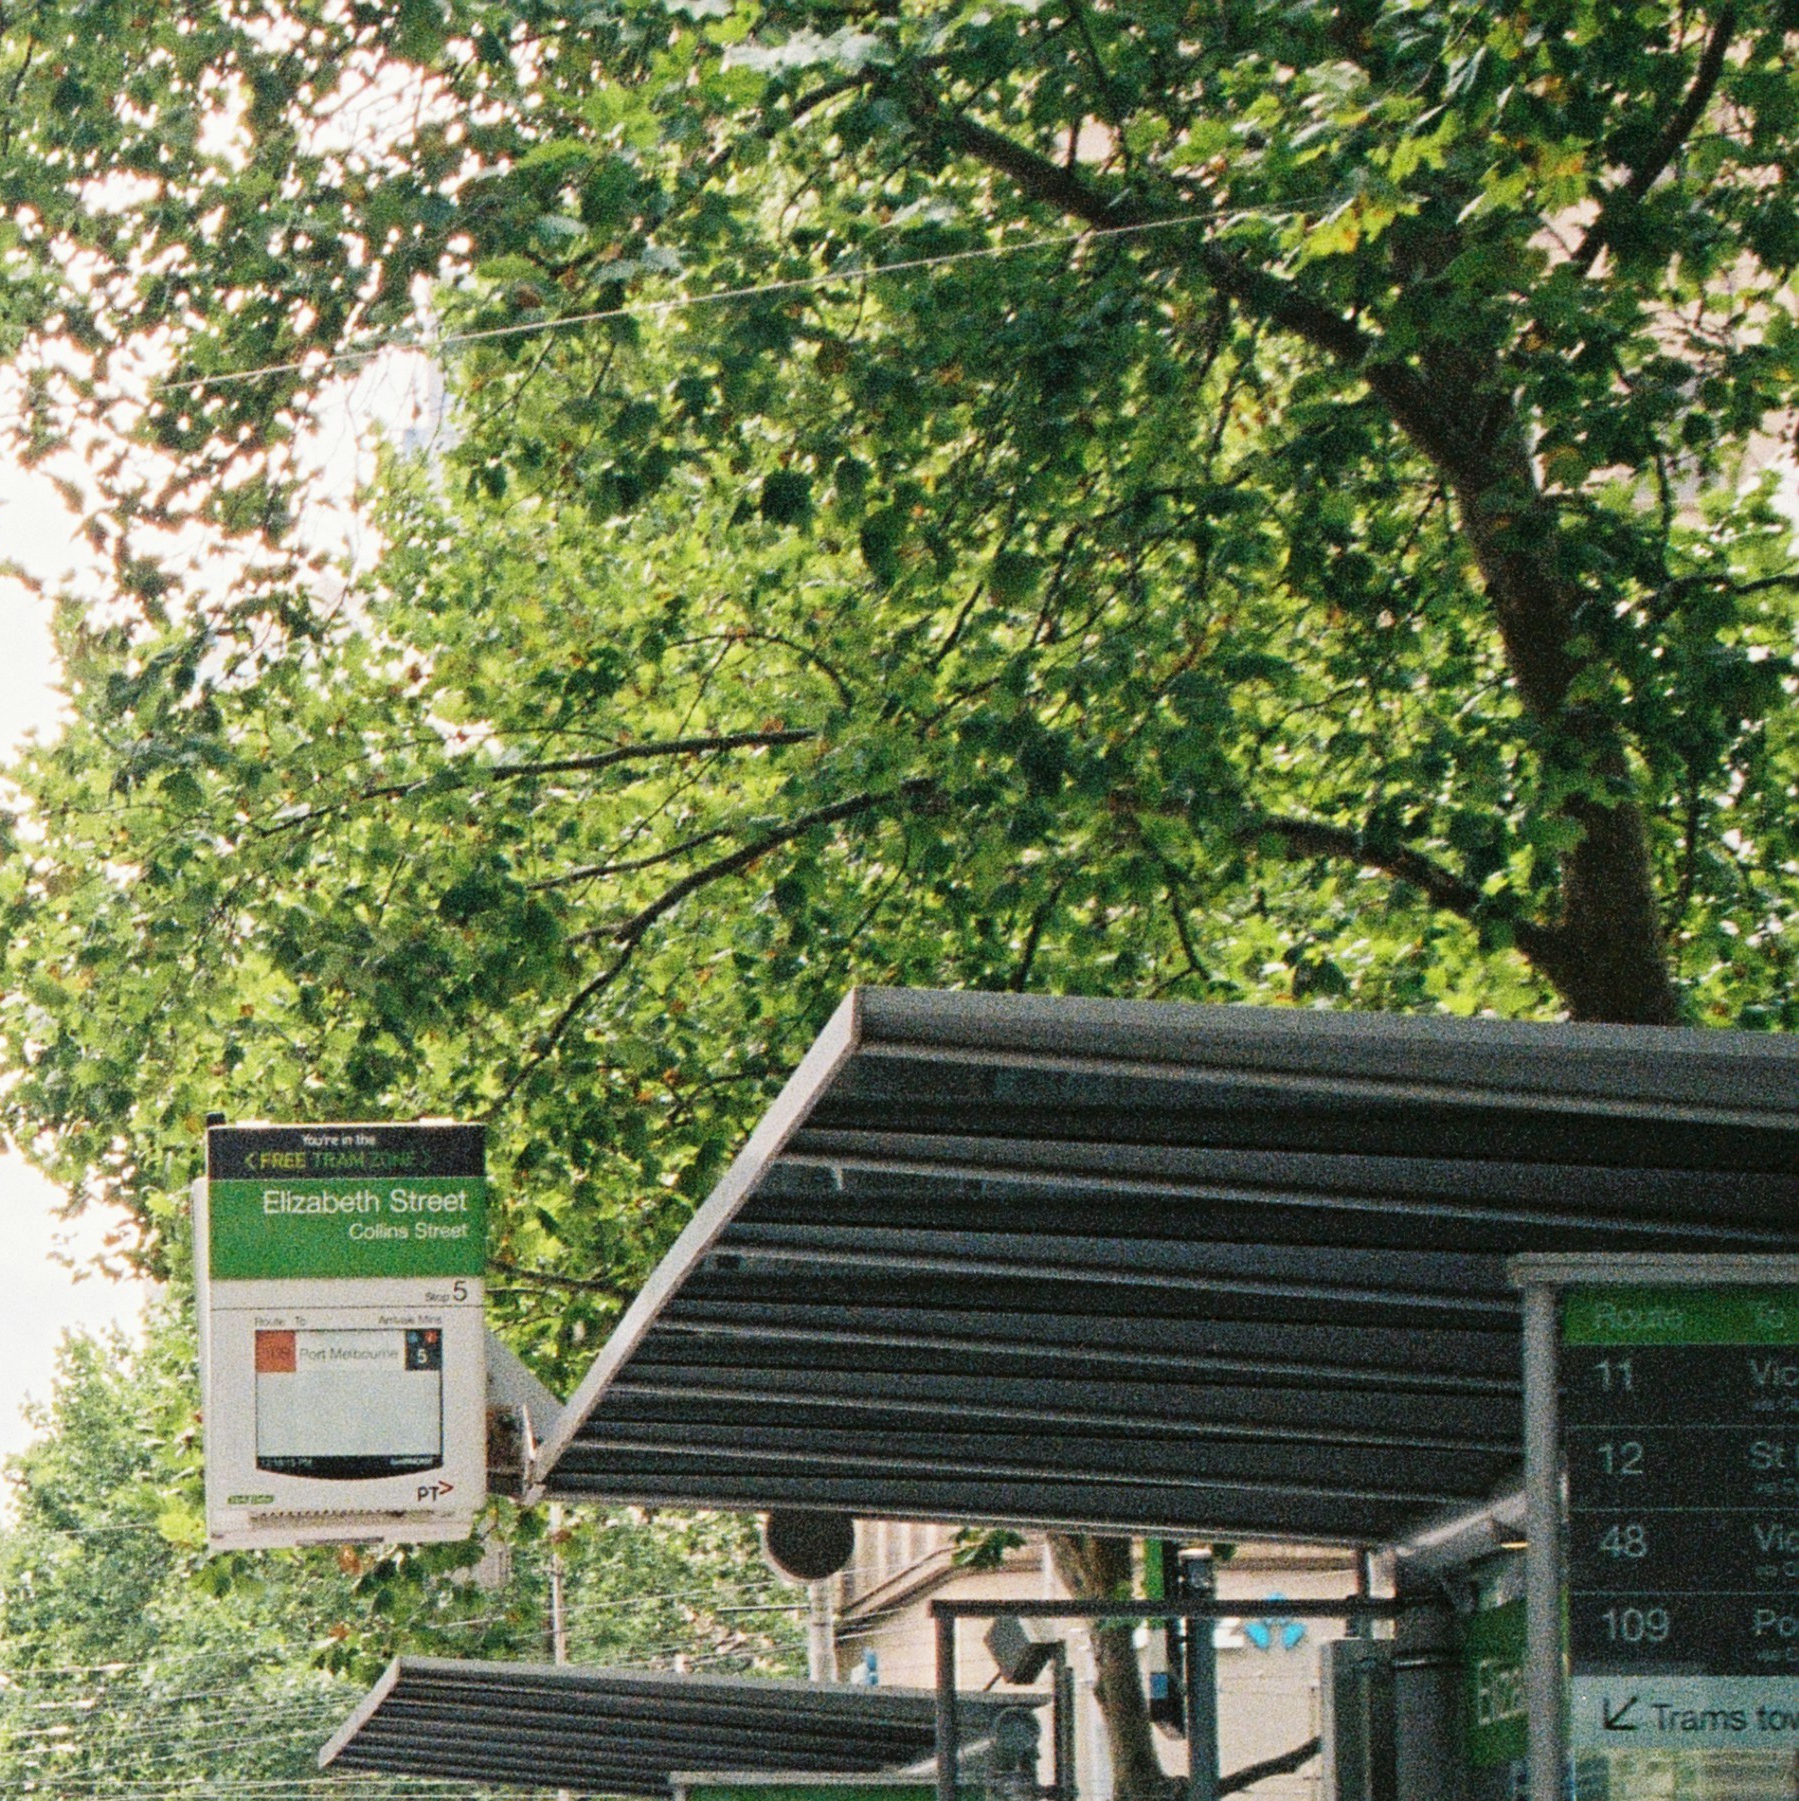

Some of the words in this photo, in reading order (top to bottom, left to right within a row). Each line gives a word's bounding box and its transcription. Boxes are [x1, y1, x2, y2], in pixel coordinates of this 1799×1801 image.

[301, 1133, 339, 1147] You're
[341, 1135, 353, 1146] in
[355, 1134, 376, 1146] the
[260, 1152, 306, 1169] FREE
[313, 1151, 365, 1168] TRAM
[370, 1152, 416, 1168] ZONE
[263, 1189, 380, 1214] Elizabeth
[390, 1189, 468, 1213] Street
[349, 1222, 410, 1240] Collins
[415, 1222, 468, 1239] Street
[453, 1280, 468, 1301] 5
[1598, 1304, 1683, 1329] Route
[300, 1347, 326, 1361] Port
[330, 1347, 399, 1361] Melbourne
[416, 1350, 428, 1364] 5
[1598, 1360, 1633, 1391] 11
[1598, 1442, 1644, 1475] 12
[1749, 1441, 1785, 1470] St
[1601, 1524, 1648, 1559] 48
[1605, 1608, 1670, 1643] 109
[1652, 1703, 1747, 1731] Trams
